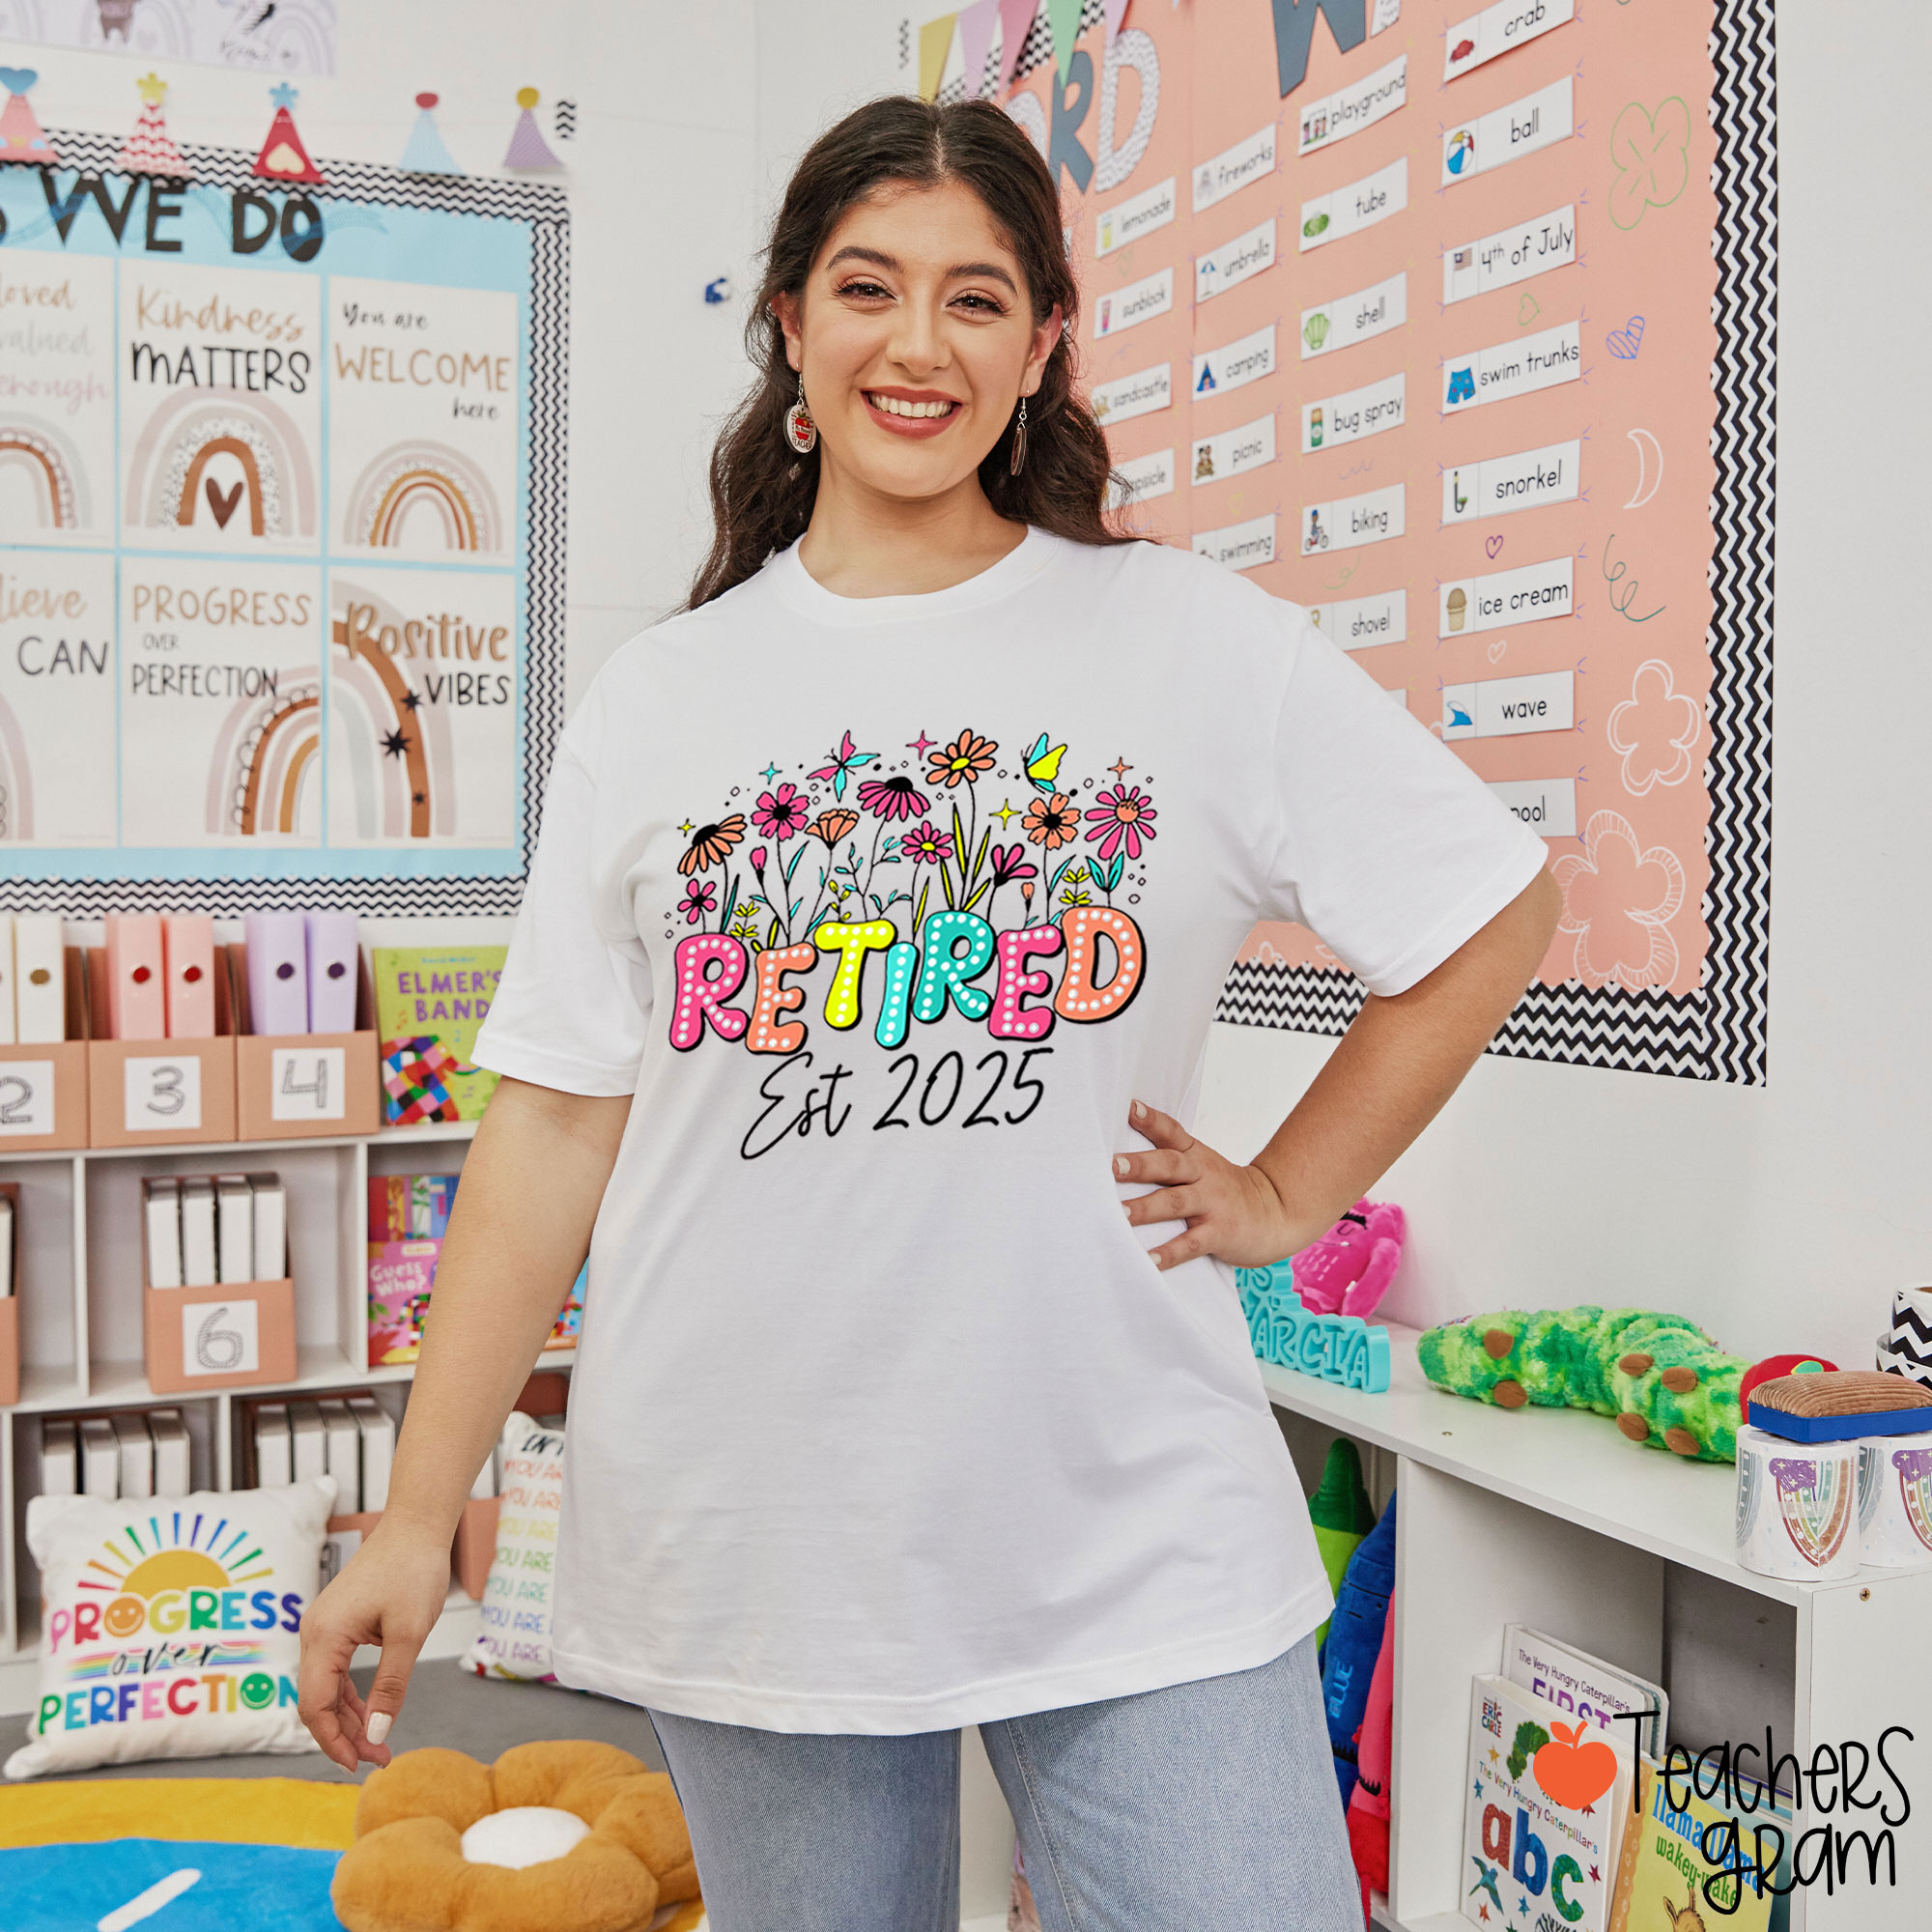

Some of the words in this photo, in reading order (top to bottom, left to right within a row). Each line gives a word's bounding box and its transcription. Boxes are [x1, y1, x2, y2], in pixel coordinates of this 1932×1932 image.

[1503, 0, 1546, 37] crab
[1329, 64, 1406, 131] playground
[1510, 106, 1540, 144] ball
[1217, 142, 1274, 188] fireworks
[40, 169, 186, 253] WE
[231, 191, 325, 263] DO
[1122, 192, 1172, 233] lemonade
[1354, 187, 1387, 218] tube
[1224, 239, 1270, 278] umbrella
[1481, 242, 1505, 274] 4th
[1511, 235, 1531, 266] of
[1538, 222, 1574, 256] July
[137, 285, 306, 342] Kindness
[343, 302, 384, 328] You
[392, 311, 428, 329] are
[1122, 281, 1165, 319] sunblock
[1355, 296, 1385, 330] shell
[335, 343, 511, 392] WELCOME
[1226, 349, 1268, 380] camping
[1480, 362, 1520, 386] swim
[1526, 340, 1579, 373] trunks
[453, 396, 499, 420] here
[1334, 409, 1360, 433] bug
[1365, 397, 1404, 428] spray
[1233, 440, 1263, 469] picnic
[1495, 459, 1562, 498] snorkel
[1351, 508, 1389, 533] biking
[1219, 535, 1272, 563] swimming
[132, 584, 311, 626] PROGRESS
[1478, 596, 1503, 616] ice
[1510, 583, 1569, 611] cream
[143, 633, 180, 651] OVER
[346, 601, 509, 662] Positive
[1351, 606, 1390, 637] shovel
[17, 635, 108, 676] CAN
[131, 663, 278, 697] PERFECTION
[425, 672, 511, 706] VIBES
[1501, 699, 1548, 720] wave
[669, 906, 1147, 1055] RETIRED
[415, 999, 490, 1022] BAND
[0, 1076, 33, 1123] 2
[146, 1065, 185, 1115] 3
[280, 1059, 327, 1109] 4
[740, 1050, 853, 1161] Est
[872, 1047, 1055, 1131] 2025
[196, 1306, 243, 1370] 6
[1241, 1299, 1370, 1388] ARCIA
[50, 1590, 302, 1654] PROGRESS
[111, 1641, 246, 1676] over
[1329, 1660, 1352, 1719] BLUE
[1520, 1648, 1532, 1665] The
[1533, 1656, 1549, 1676] Very
[1551, 1665, 1579, 1691] Hungry
[1580, 1680, 1631, 1714] Caterpillar's
[38, 1672, 299, 1736] PERFECTION
[1483, 1701, 1502, 1724] ERIC
[1481, 1715, 1502, 1739] CARLE
[1479, 1761, 1492, 1779] The
[1494, 1773, 1512, 1797] Very
[1513, 1786, 1542, 1819] Hungry
[1544, 1809, 1598, 1855] Caterpillar's
[1652, 1783, 1704, 1853] llama
[1482, 1803, 1584, 1922] abc
